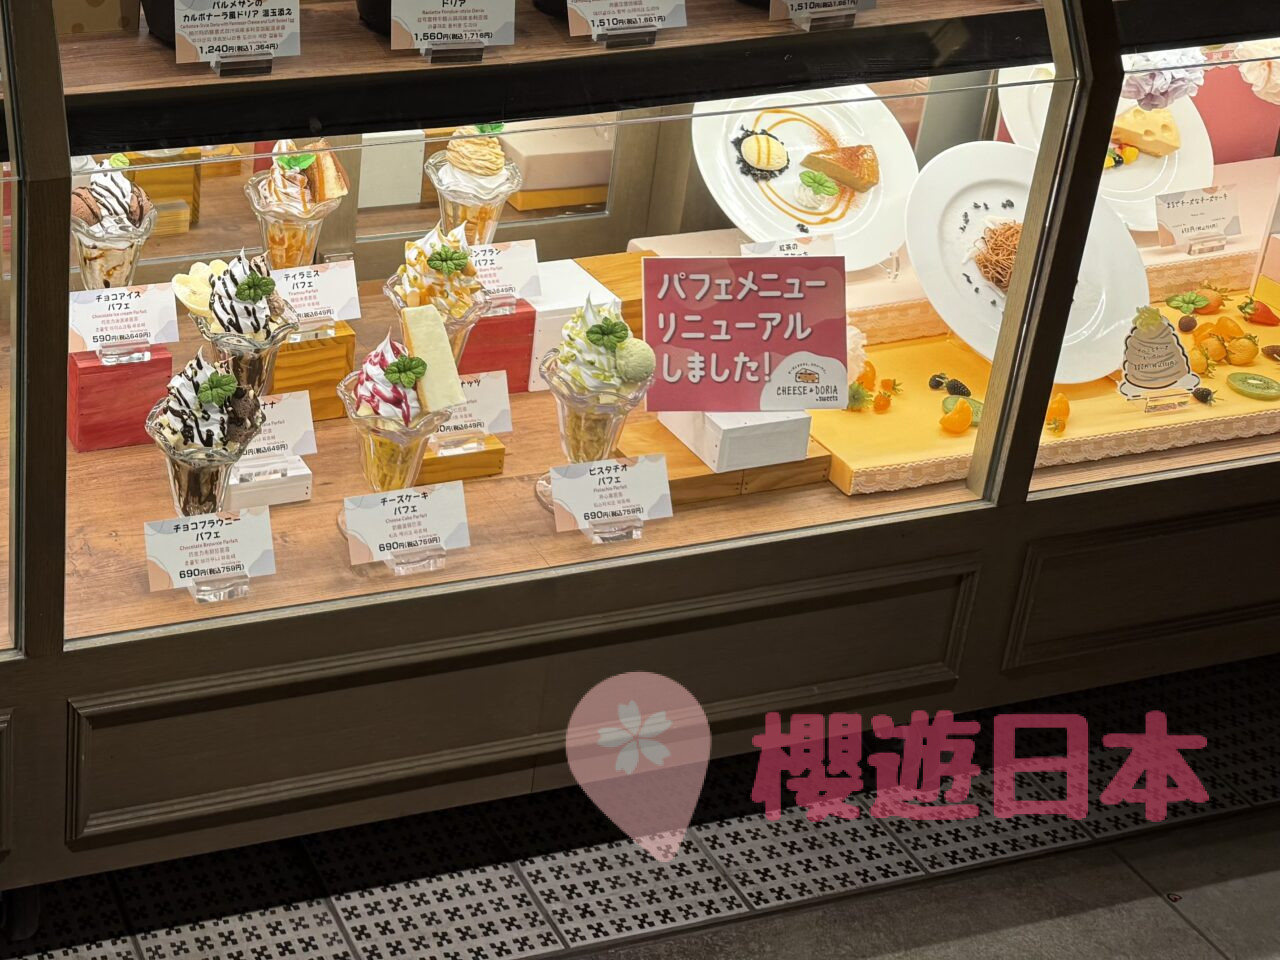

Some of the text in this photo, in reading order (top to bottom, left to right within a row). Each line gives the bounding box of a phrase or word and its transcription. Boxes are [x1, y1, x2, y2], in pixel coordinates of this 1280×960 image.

[442, 0, 466, 8] ドリア
[183, 10, 258, 23] カルボナーラ風ドリア
[779, 243, 798, 252] 紅茶の
[284, 270, 320, 282] ティラミス
[292, 281, 314, 290] パフェ
[657, 271, 827, 301] パフェメニュー
[95, 291, 141, 302] チョコアイス
[108, 303, 130, 311] パフェ
[657, 311, 812, 343] リニューアル
[662, 351, 772, 384] しました!
[776, 385, 838, 396] CHEESE DORIA
[589, 464, 628, 476] ピスタチオ
[598, 476, 621, 486] パフェ
[380, 492, 429, 506] チーズケーキ
[394, 505, 418, 515] パフェ
[173, 517, 241, 533] チョコブラウニー
[196, 531, 221, 541] パフェ
[378, 536, 440, 552] 690円(税込759円)
[179, 564, 245, 579] 690円(税込759円)
